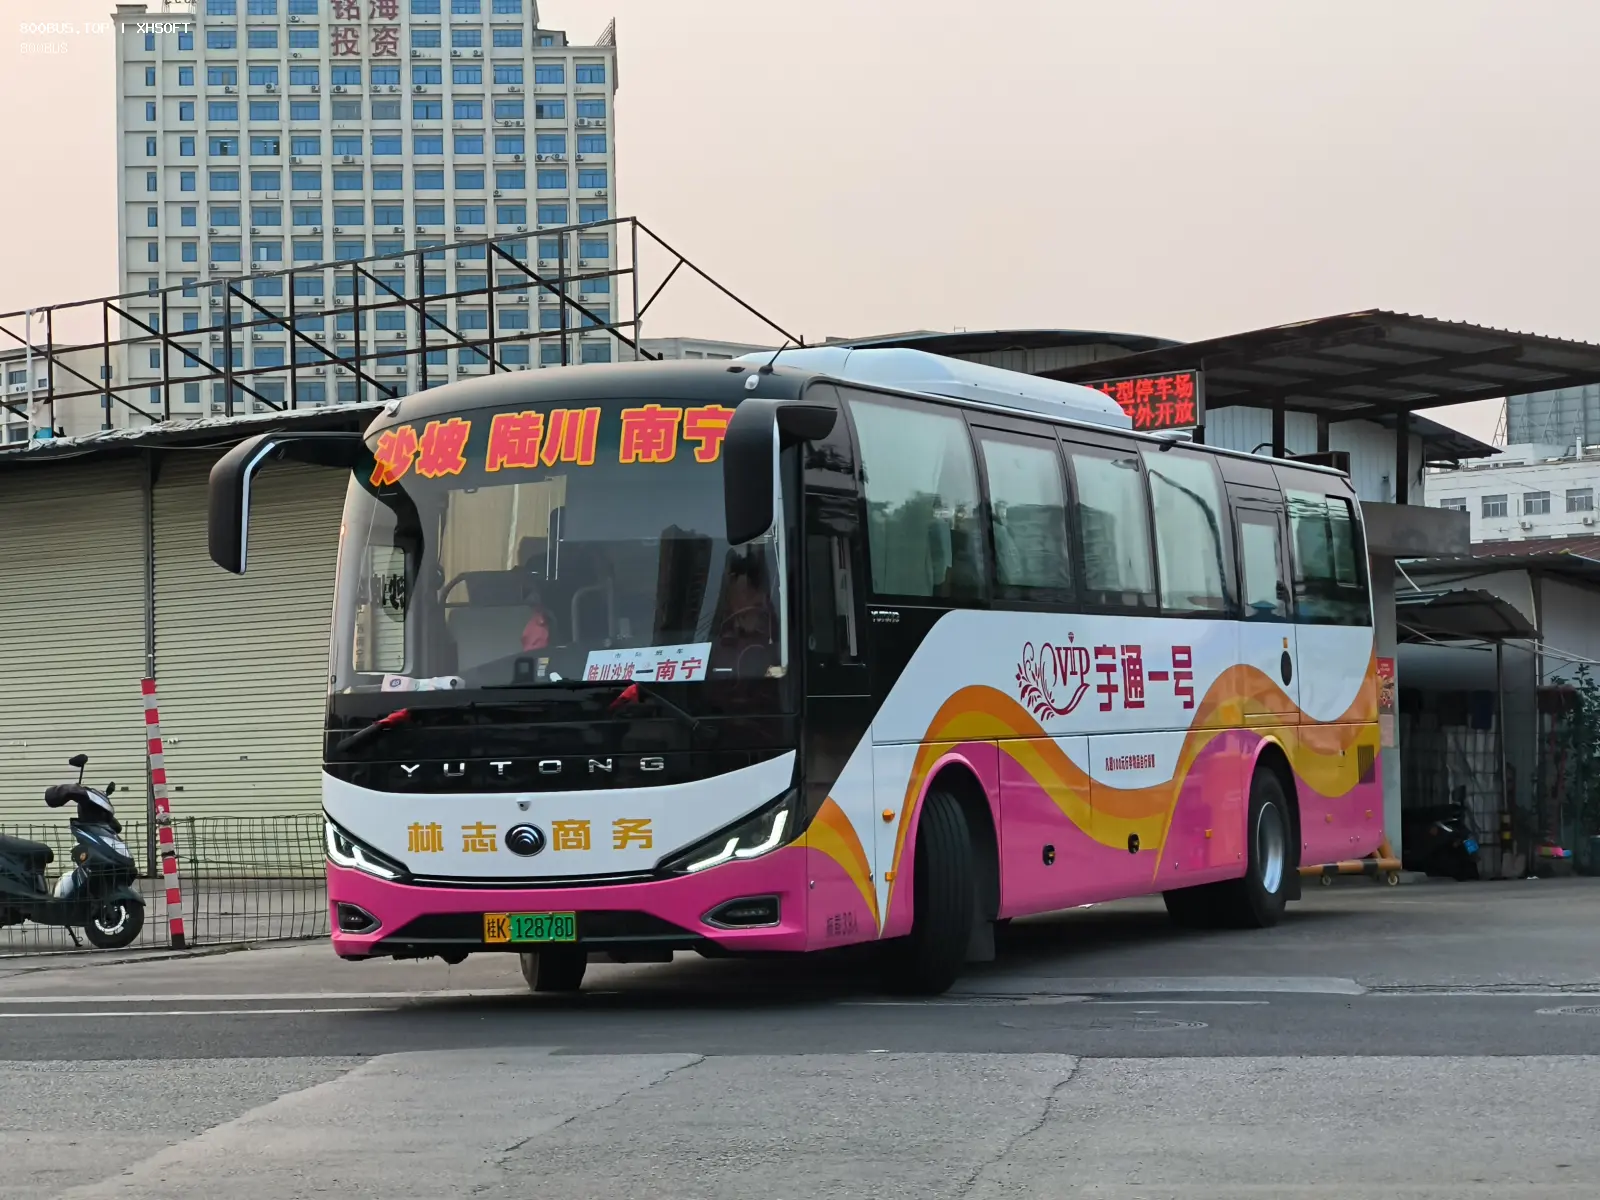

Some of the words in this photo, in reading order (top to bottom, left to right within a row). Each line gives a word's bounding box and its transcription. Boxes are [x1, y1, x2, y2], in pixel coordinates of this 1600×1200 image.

[331, 25, 399, 57] 投资
[1085, 373, 1195, 405] 大型停车场
[370, 417, 471, 487] 沙坡
[485, 406, 601, 472] 陆川
[619, 404, 737, 464] 南宁
[1093, 644, 1195, 712] 宇通一号
[400, 757, 665, 777] YUTONG
[407, 821, 498, 853] 林志
[551, 818, 653, 851] 商务
